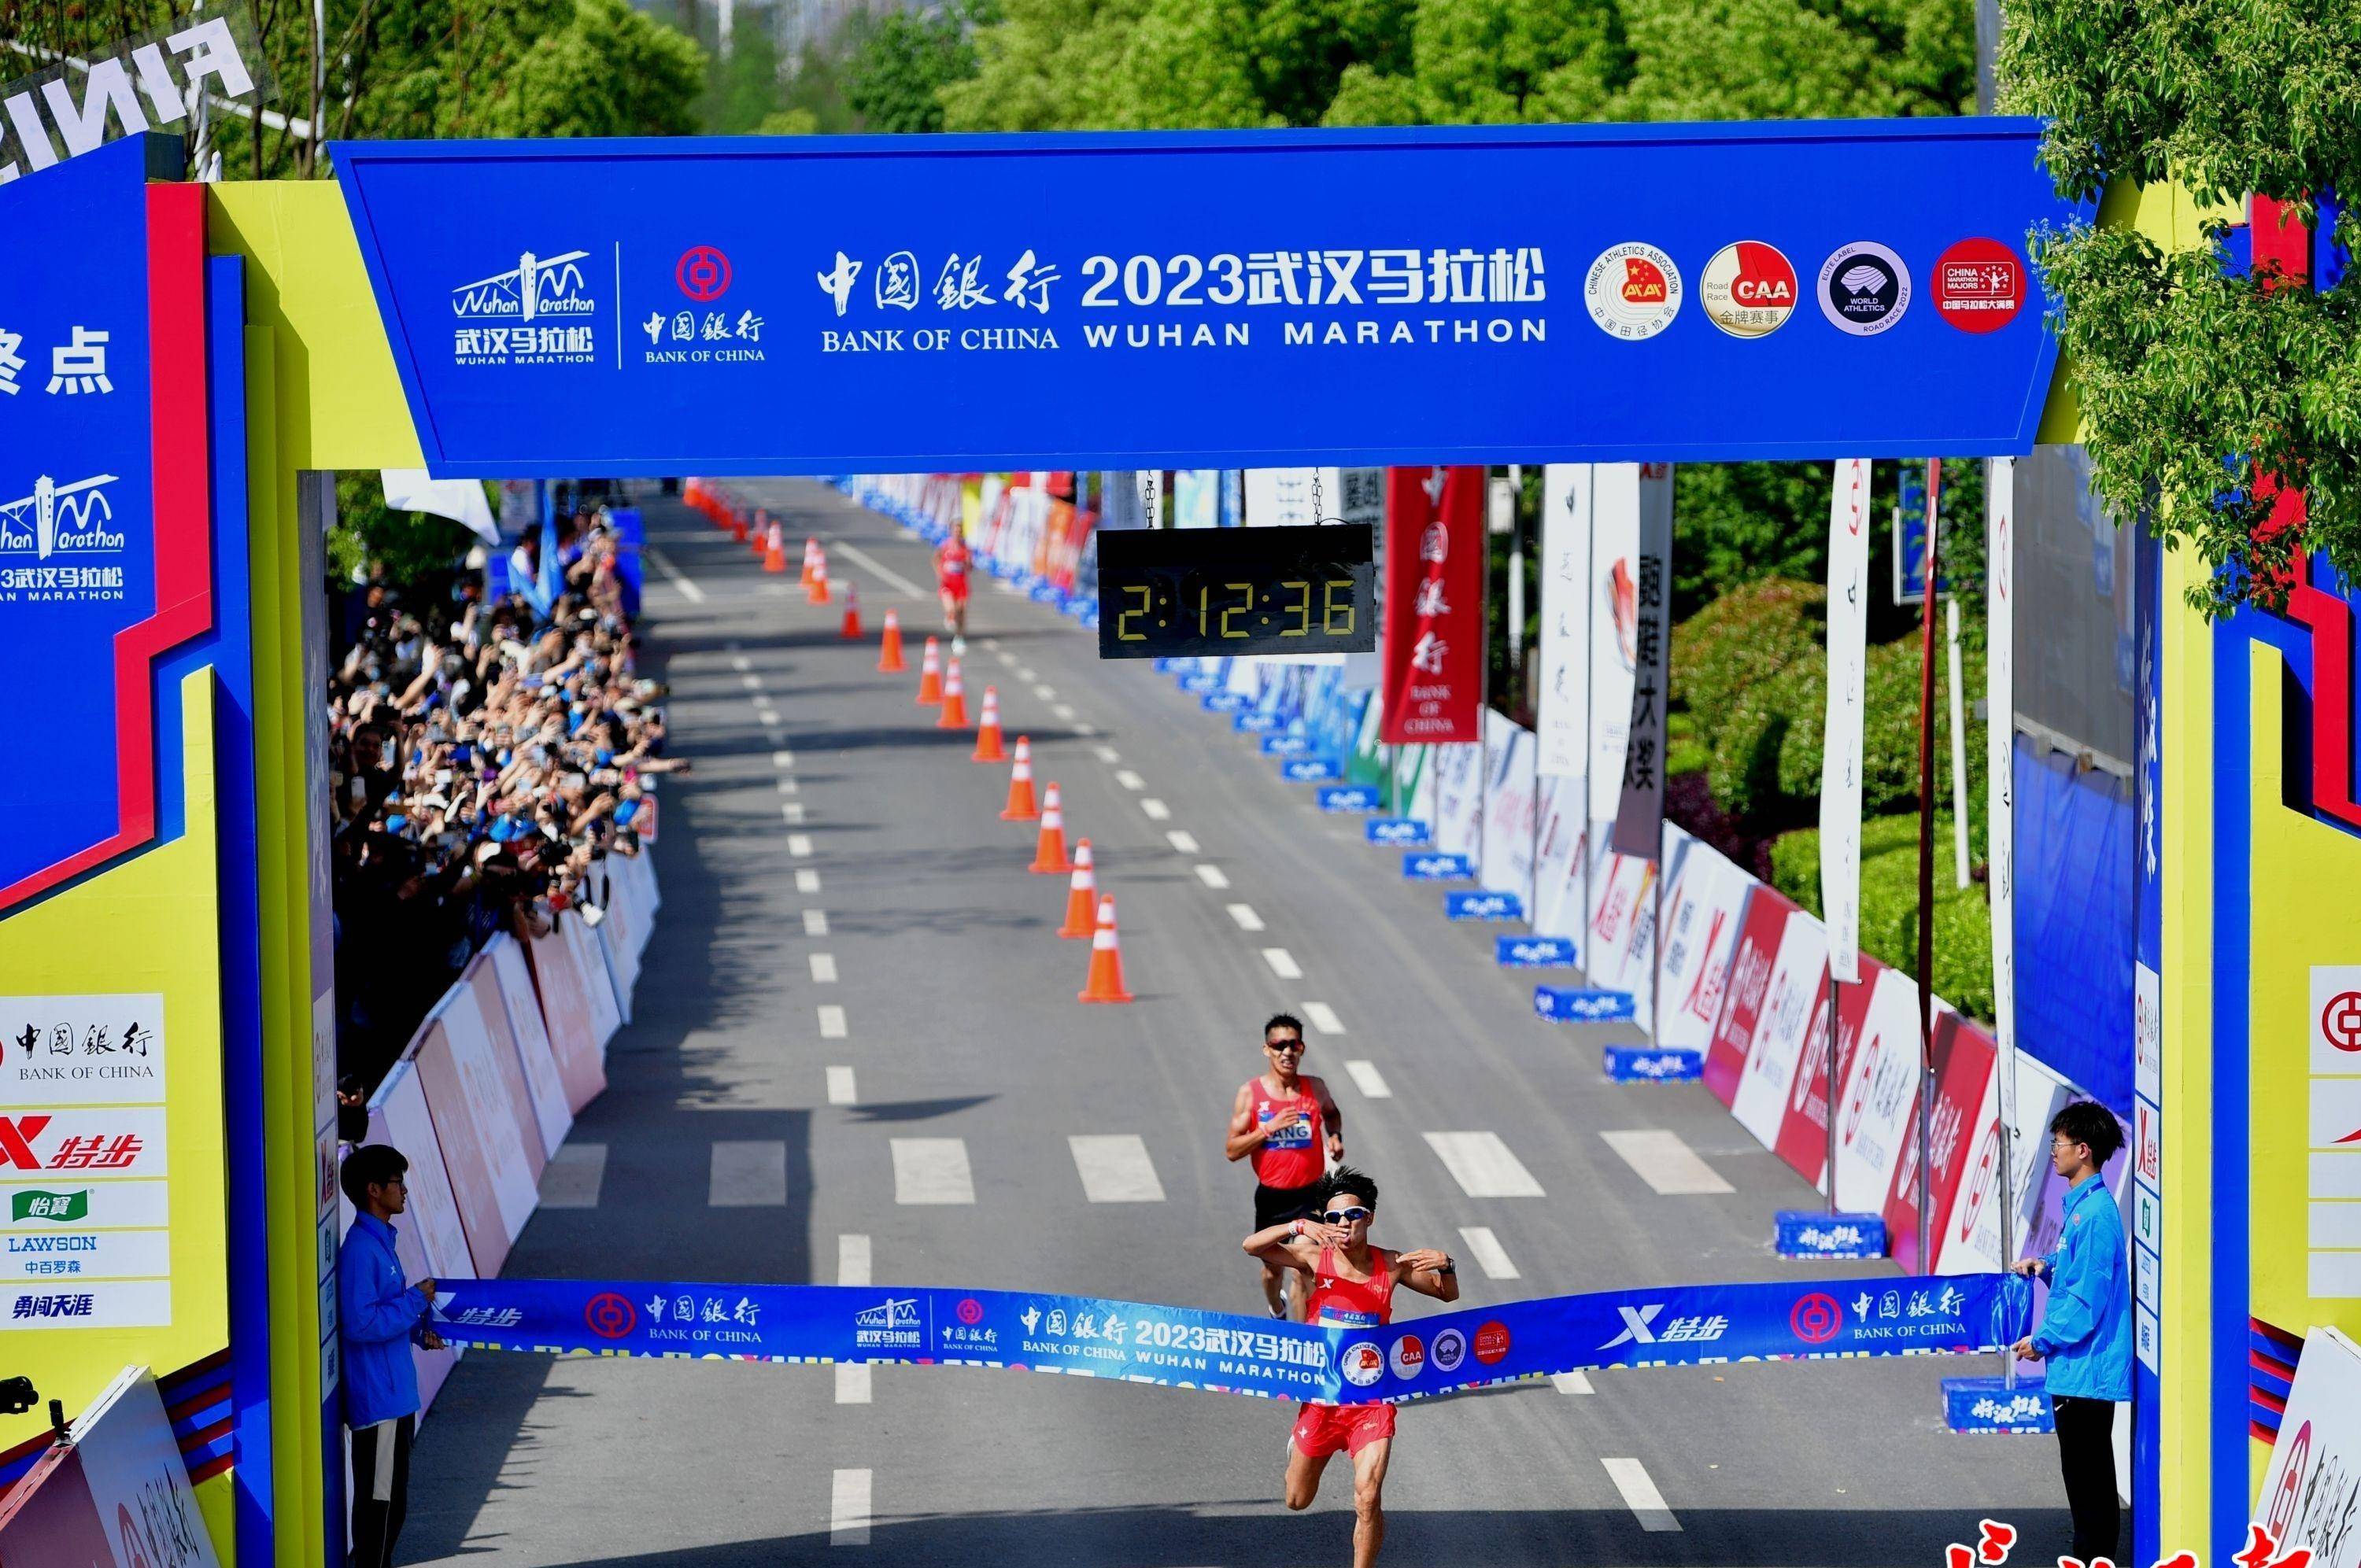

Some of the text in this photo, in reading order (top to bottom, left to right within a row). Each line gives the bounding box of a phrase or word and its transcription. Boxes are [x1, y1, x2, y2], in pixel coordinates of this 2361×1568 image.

[1834, 247, 1857, 263] LABEL
[1081, 248, 1546, 307] 2023武汉马拉松
[1589, 246, 1679, 294] CHINESE ATHLETICS ASSOCIATION
[1947, 268, 1978, 277] CHINA
[1738, 281, 1790, 299] CAA
[1720, 310, 1779, 324] 金牌赛事
[1863, 286, 1908, 332] ROAD RACE 2022
[455, 327, 593, 354] 武汉马拉松
[822, 327, 1059, 352] BANK OF CHINA
[1084, 319, 1546, 347] WUHAN MARATHON
[456, 353, 594, 365] WUHAN MARATHON
[645, 349, 765, 363] BANK OF CHINA
[28, 590, 124, 601] MARATHON
[1118, 581, 1354, 640] 2:12:36
[19, 1064, 153, 1080] BANK OF CHINA
[45, 1134, 143, 1169] 特步
[9, 1237, 97, 1252] LAWSON
[24, 1261, 81, 1275] 中百罗森
[12, 1294, 94, 1319] 勇闯天涯
[457, 1308, 523, 1326] 特步
[649, 1328, 762, 1342] BANK OF CHINA
[856, 1330, 920, 1344] 武汉马拉松
[1657, 1315, 1729, 1342] 特步
[1854, 1323, 1966, 1339] BANK OF CHINA
[1023, 1341, 1126, 1360] BANK OF CHINA
[1135, 1320, 1326, 1367] 2023武汉马拉松
[1402, 1351, 1422, 1363] CAA
[1136, 1351, 1206, 1370] WUHAN
[1219, 1360, 1325, 1386] MARATHON
